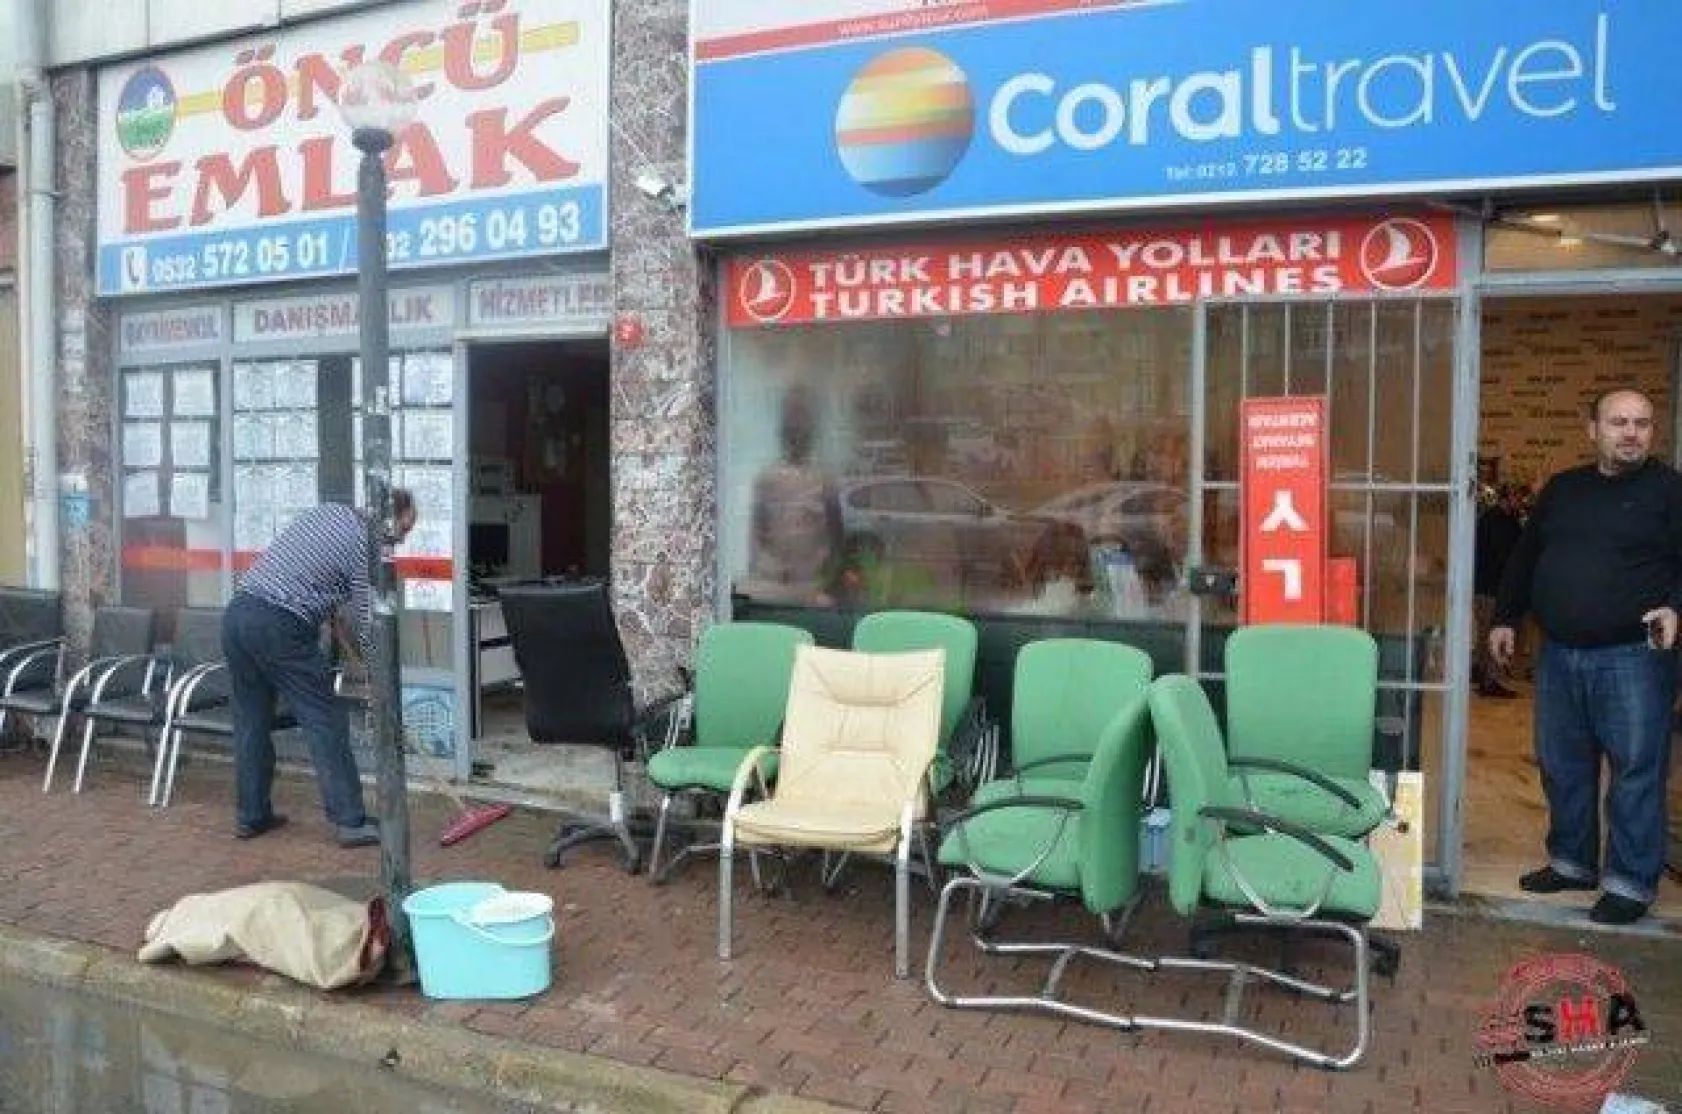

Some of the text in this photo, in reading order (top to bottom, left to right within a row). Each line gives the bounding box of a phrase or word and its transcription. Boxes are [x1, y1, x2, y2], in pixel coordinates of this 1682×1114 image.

[120, 97, 580, 235] EMLAK
[1297, 151, 1327, 171] 52
[1337, 147, 1368, 169] 22
[203, 240, 249, 278] 572
[257, 235, 290, 273] 05
[297, 231, 329, 268] 01
[418, 213, 477, 258] 296
[484, 208, 528, 249] 04
[537, 201, 580, 245] 93
[809, 230, 1341, 290] TÜRK HAVA YOLLARI
[810, 264, 1344, 319] TURKISH AIRLINES
